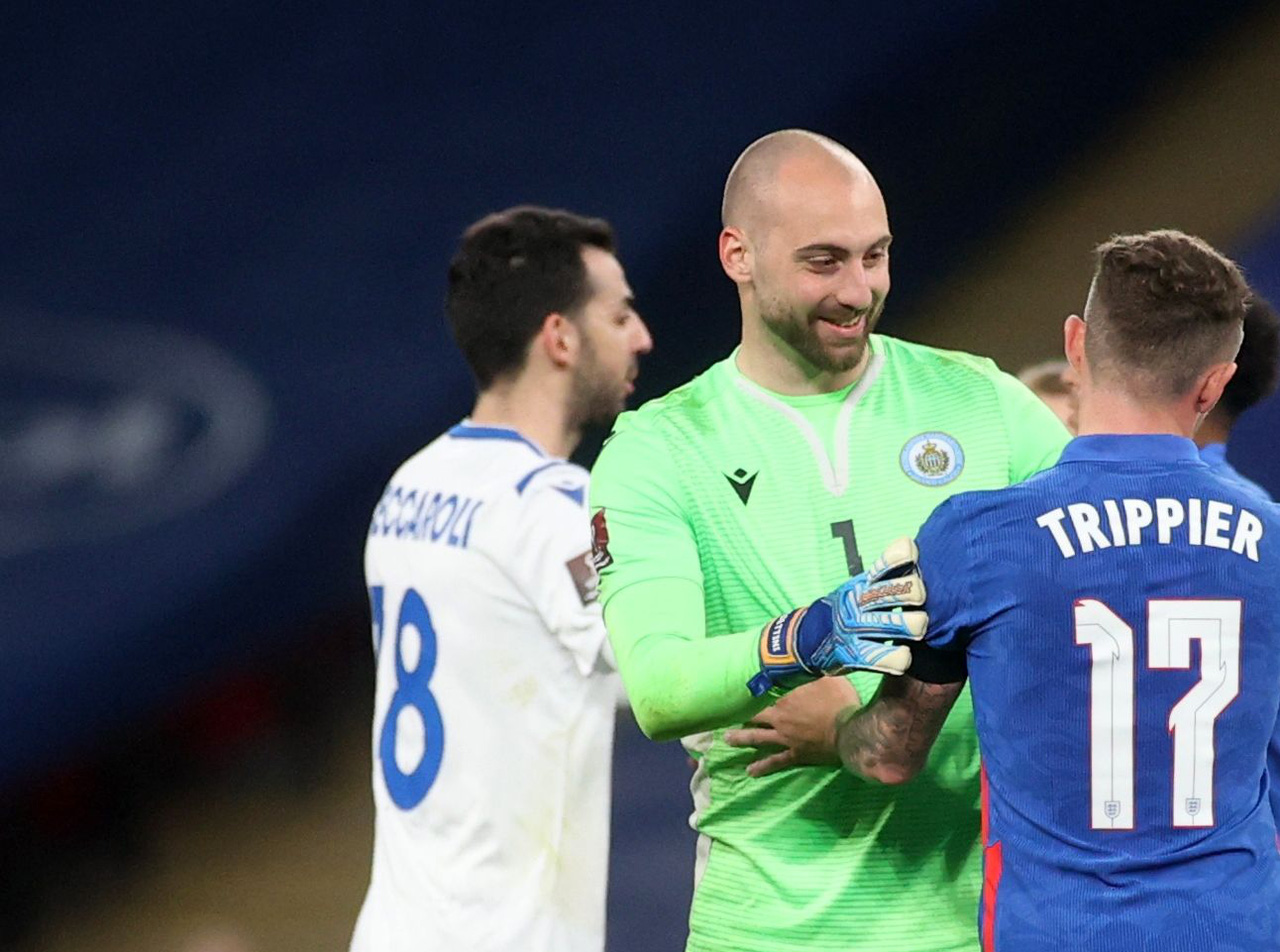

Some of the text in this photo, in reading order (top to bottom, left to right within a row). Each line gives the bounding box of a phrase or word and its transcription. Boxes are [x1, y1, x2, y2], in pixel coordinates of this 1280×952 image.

[830, 519, 865, 577] 1
[1036, 498, 1263, 562] TRIPPIER
[370, 585, 445, 812] 8
[1073, 598, 1244, 830] 17
